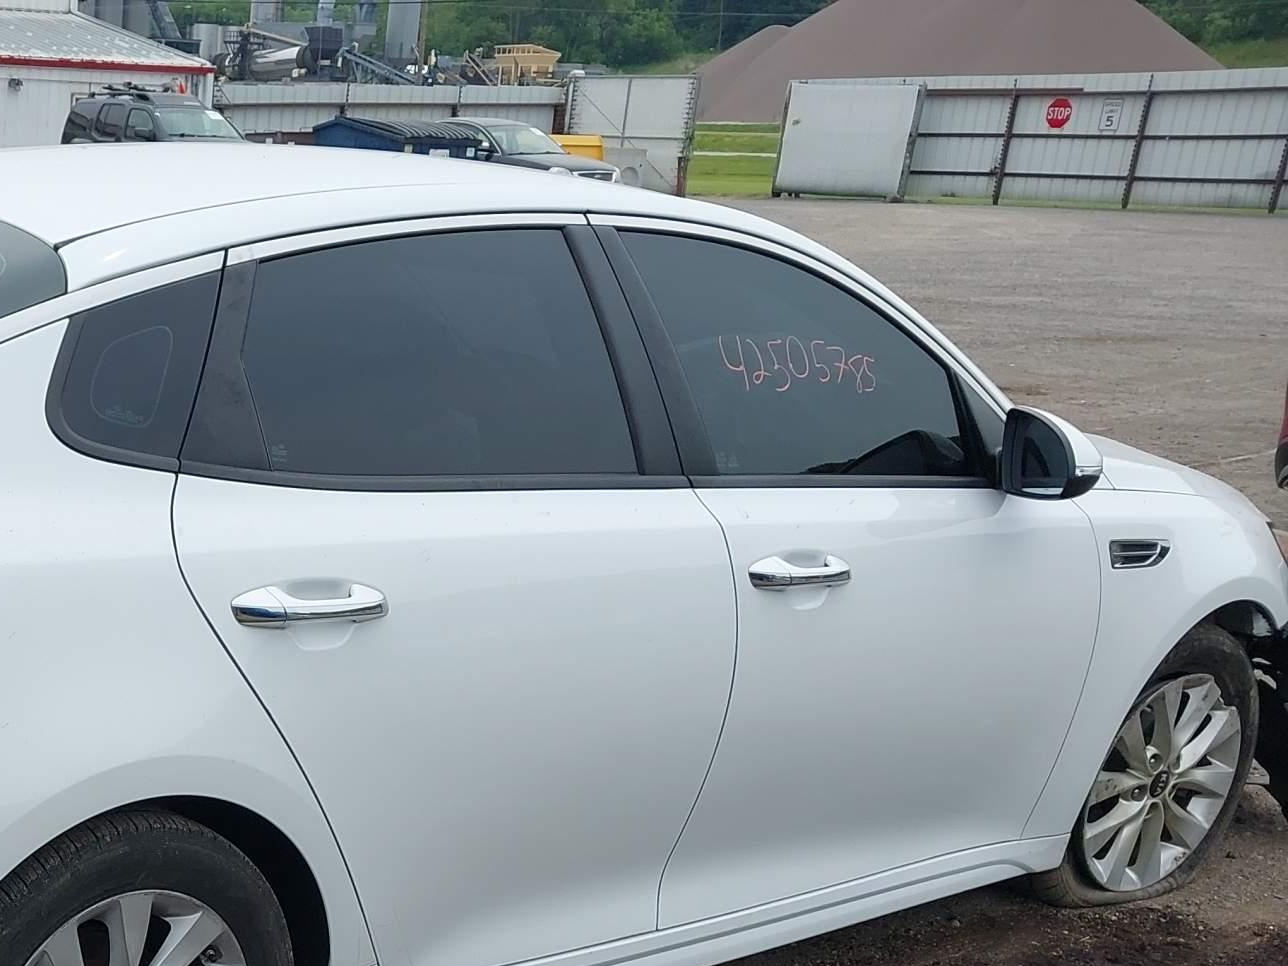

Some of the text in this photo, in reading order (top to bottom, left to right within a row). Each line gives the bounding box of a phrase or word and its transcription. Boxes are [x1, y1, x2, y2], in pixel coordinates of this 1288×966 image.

[1047, 107, 1072, 120] STOP
[1104, 115, 1114, 127] 5
[719, 335, 876, 393] 42505785
